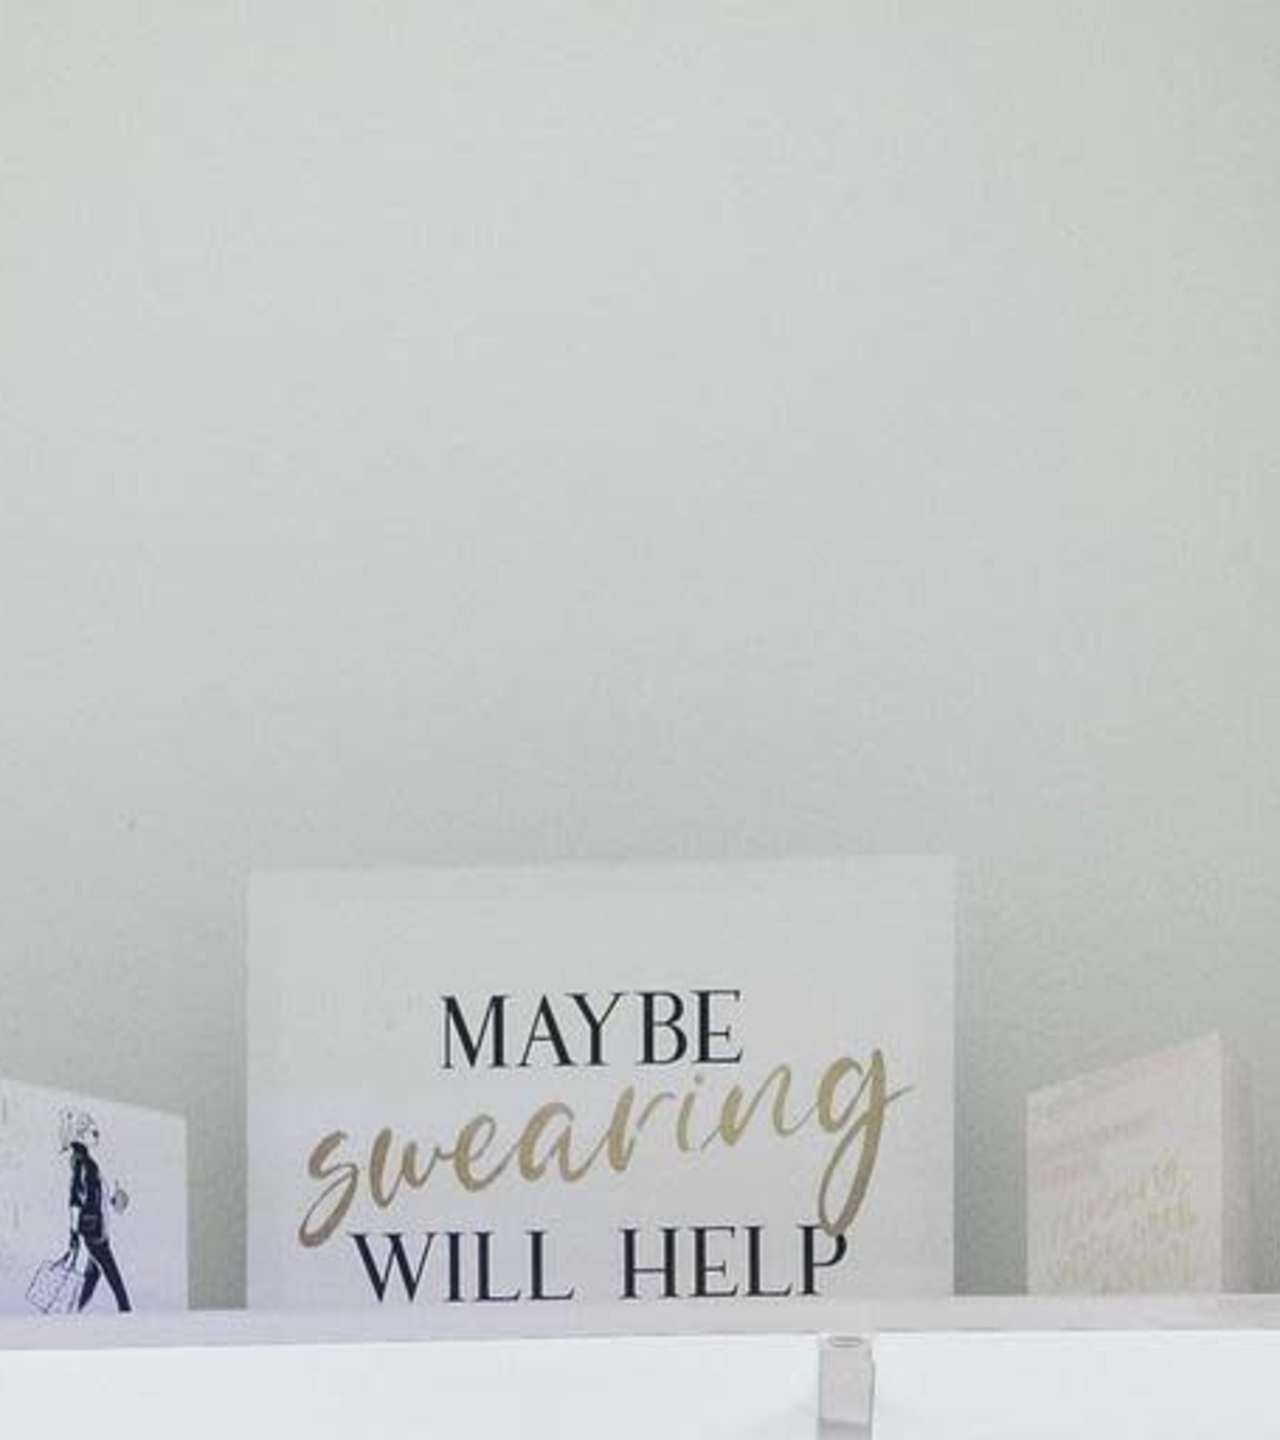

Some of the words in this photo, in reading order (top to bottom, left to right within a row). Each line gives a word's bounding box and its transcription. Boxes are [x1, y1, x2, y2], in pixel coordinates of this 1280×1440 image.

[440, 989, 743, 1070] MAYBE
[297, 1048, 914, 1248] swearing
[347, 1231, 576, 1303] WILL
[620, 1225, 848, 1299] HELP
